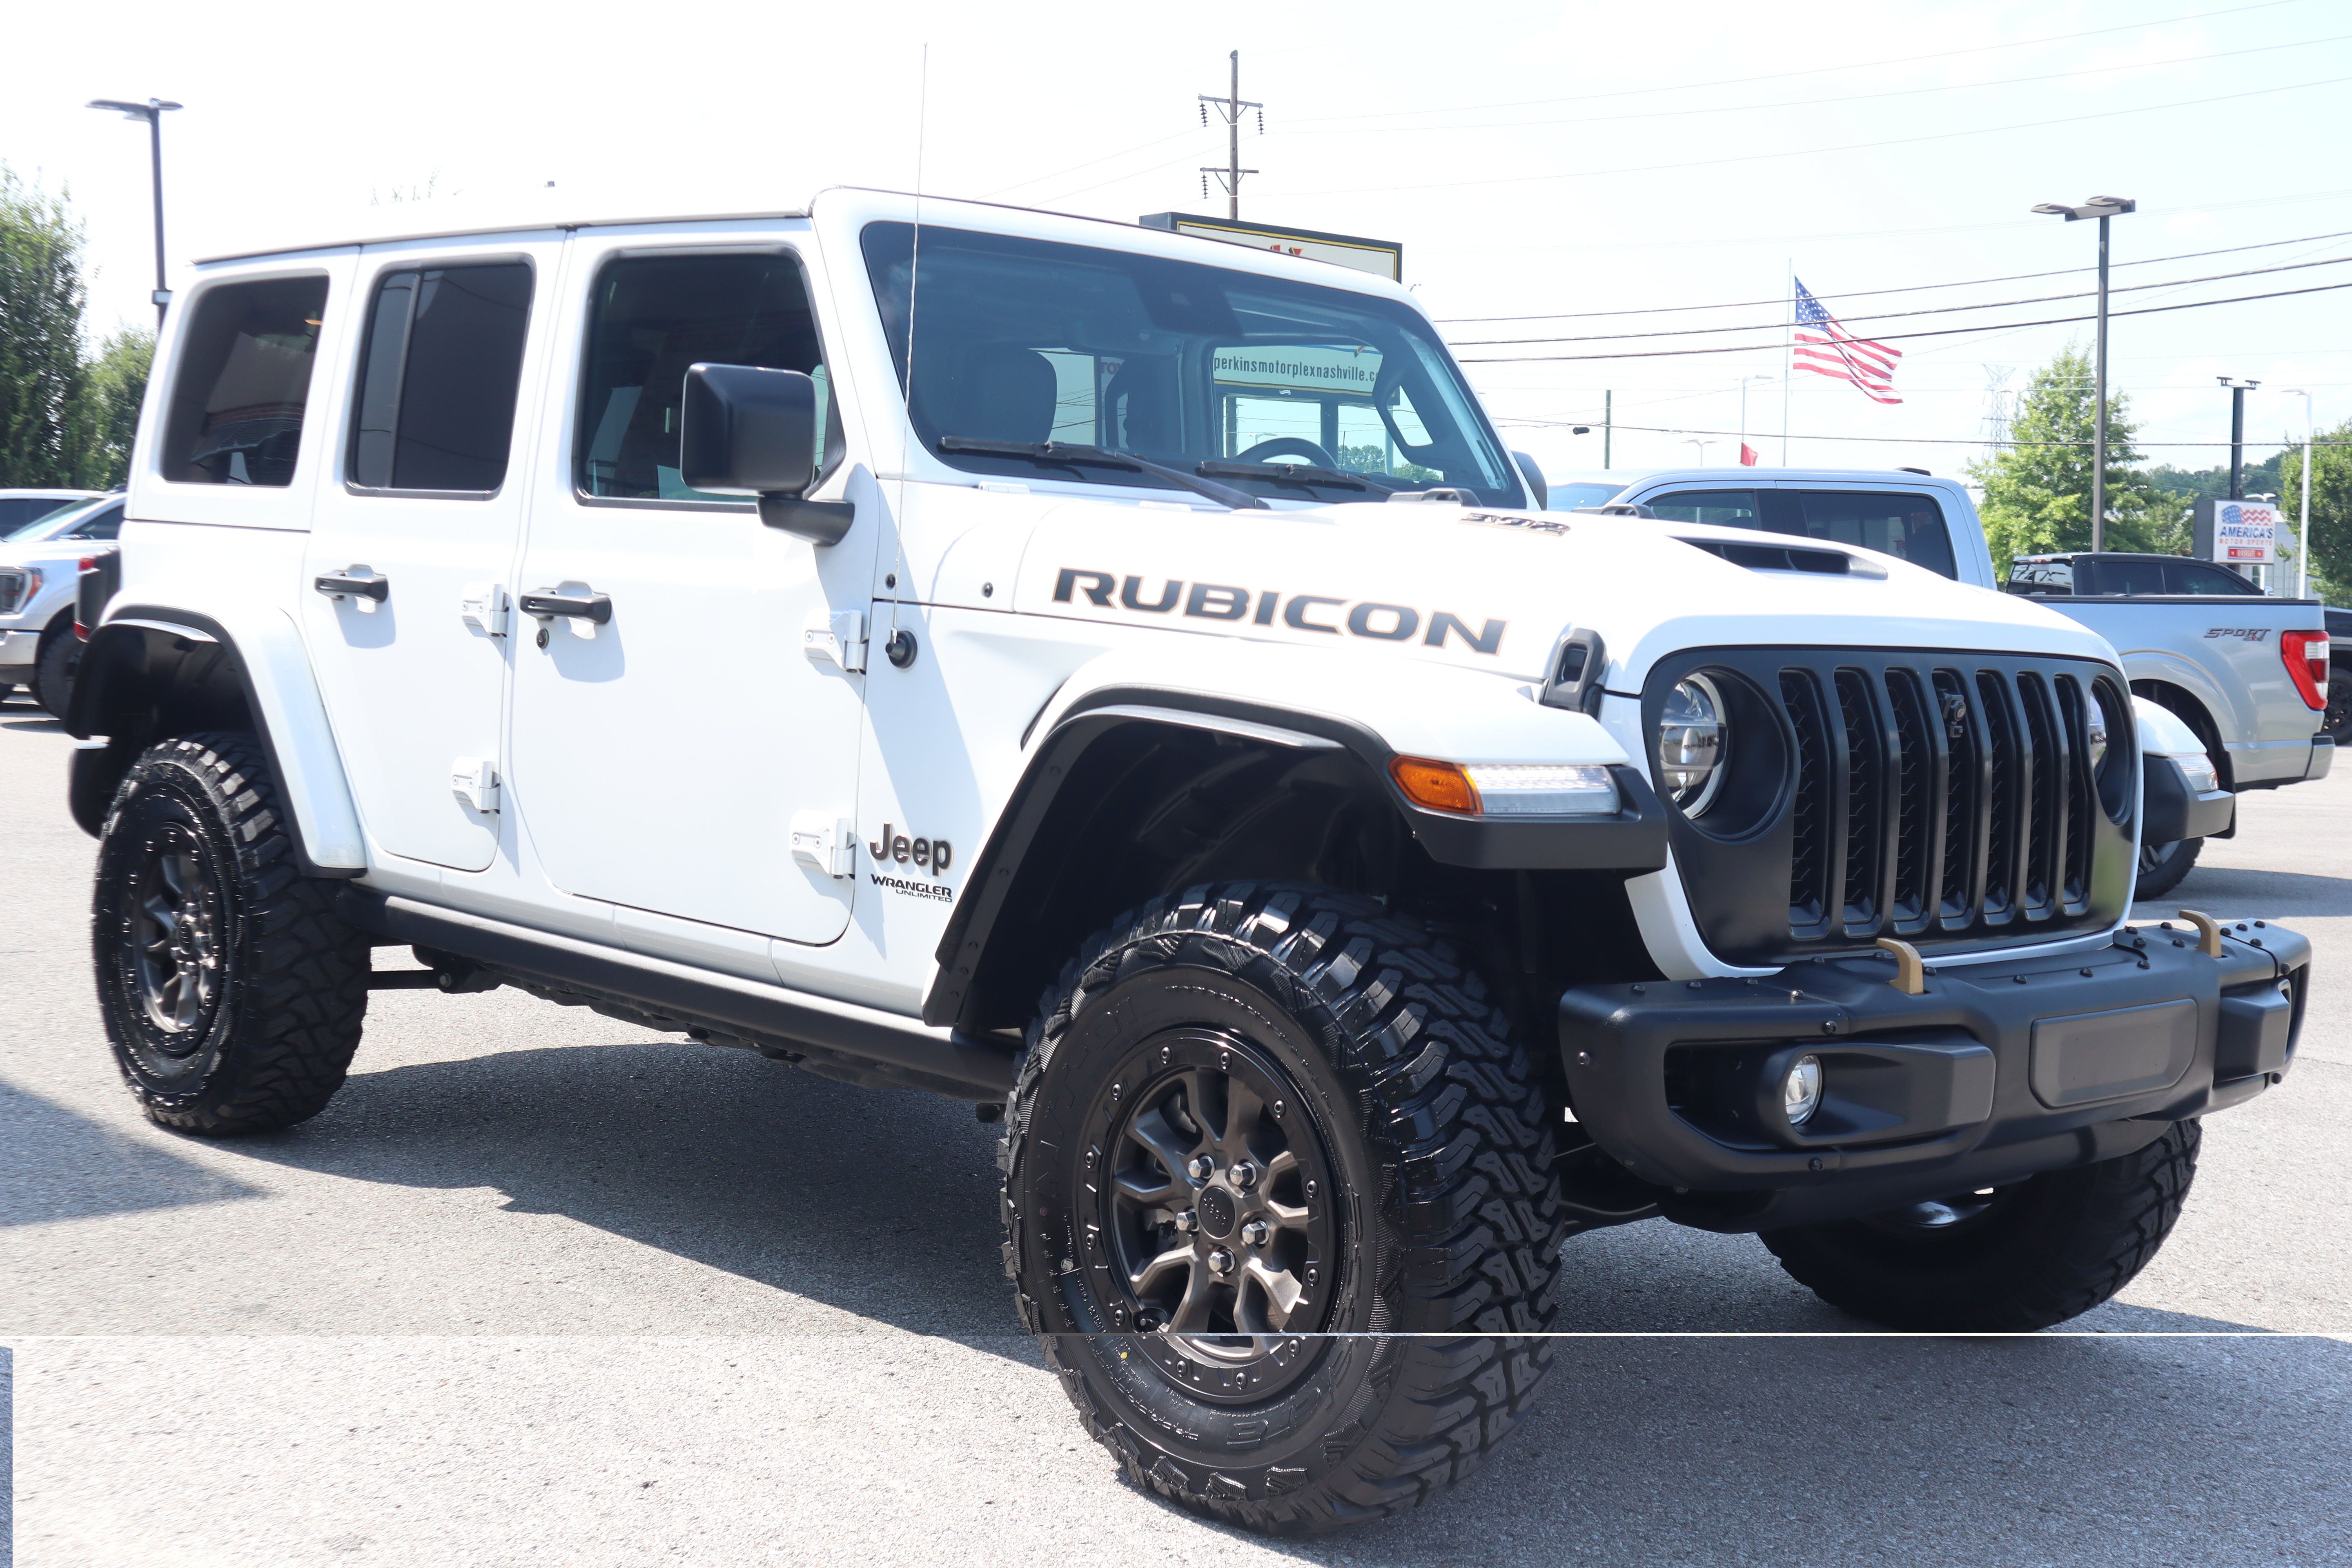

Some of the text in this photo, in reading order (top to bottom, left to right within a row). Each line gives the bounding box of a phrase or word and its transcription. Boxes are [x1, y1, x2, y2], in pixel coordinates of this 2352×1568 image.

[1214, 356, 1379, 382] perkinsmotorplexnashville.c
[2220, 526, 2273, 539] AMERICA'S
[1051, 566, 1510, 657] RUBICON
[2204, 628, 2272, 638] SPORT
[869, 821, 954, 878] Jeep
[870, 873, 953, 898] WRANGLER
[896, 889, 953, 903] UNLIMITED
